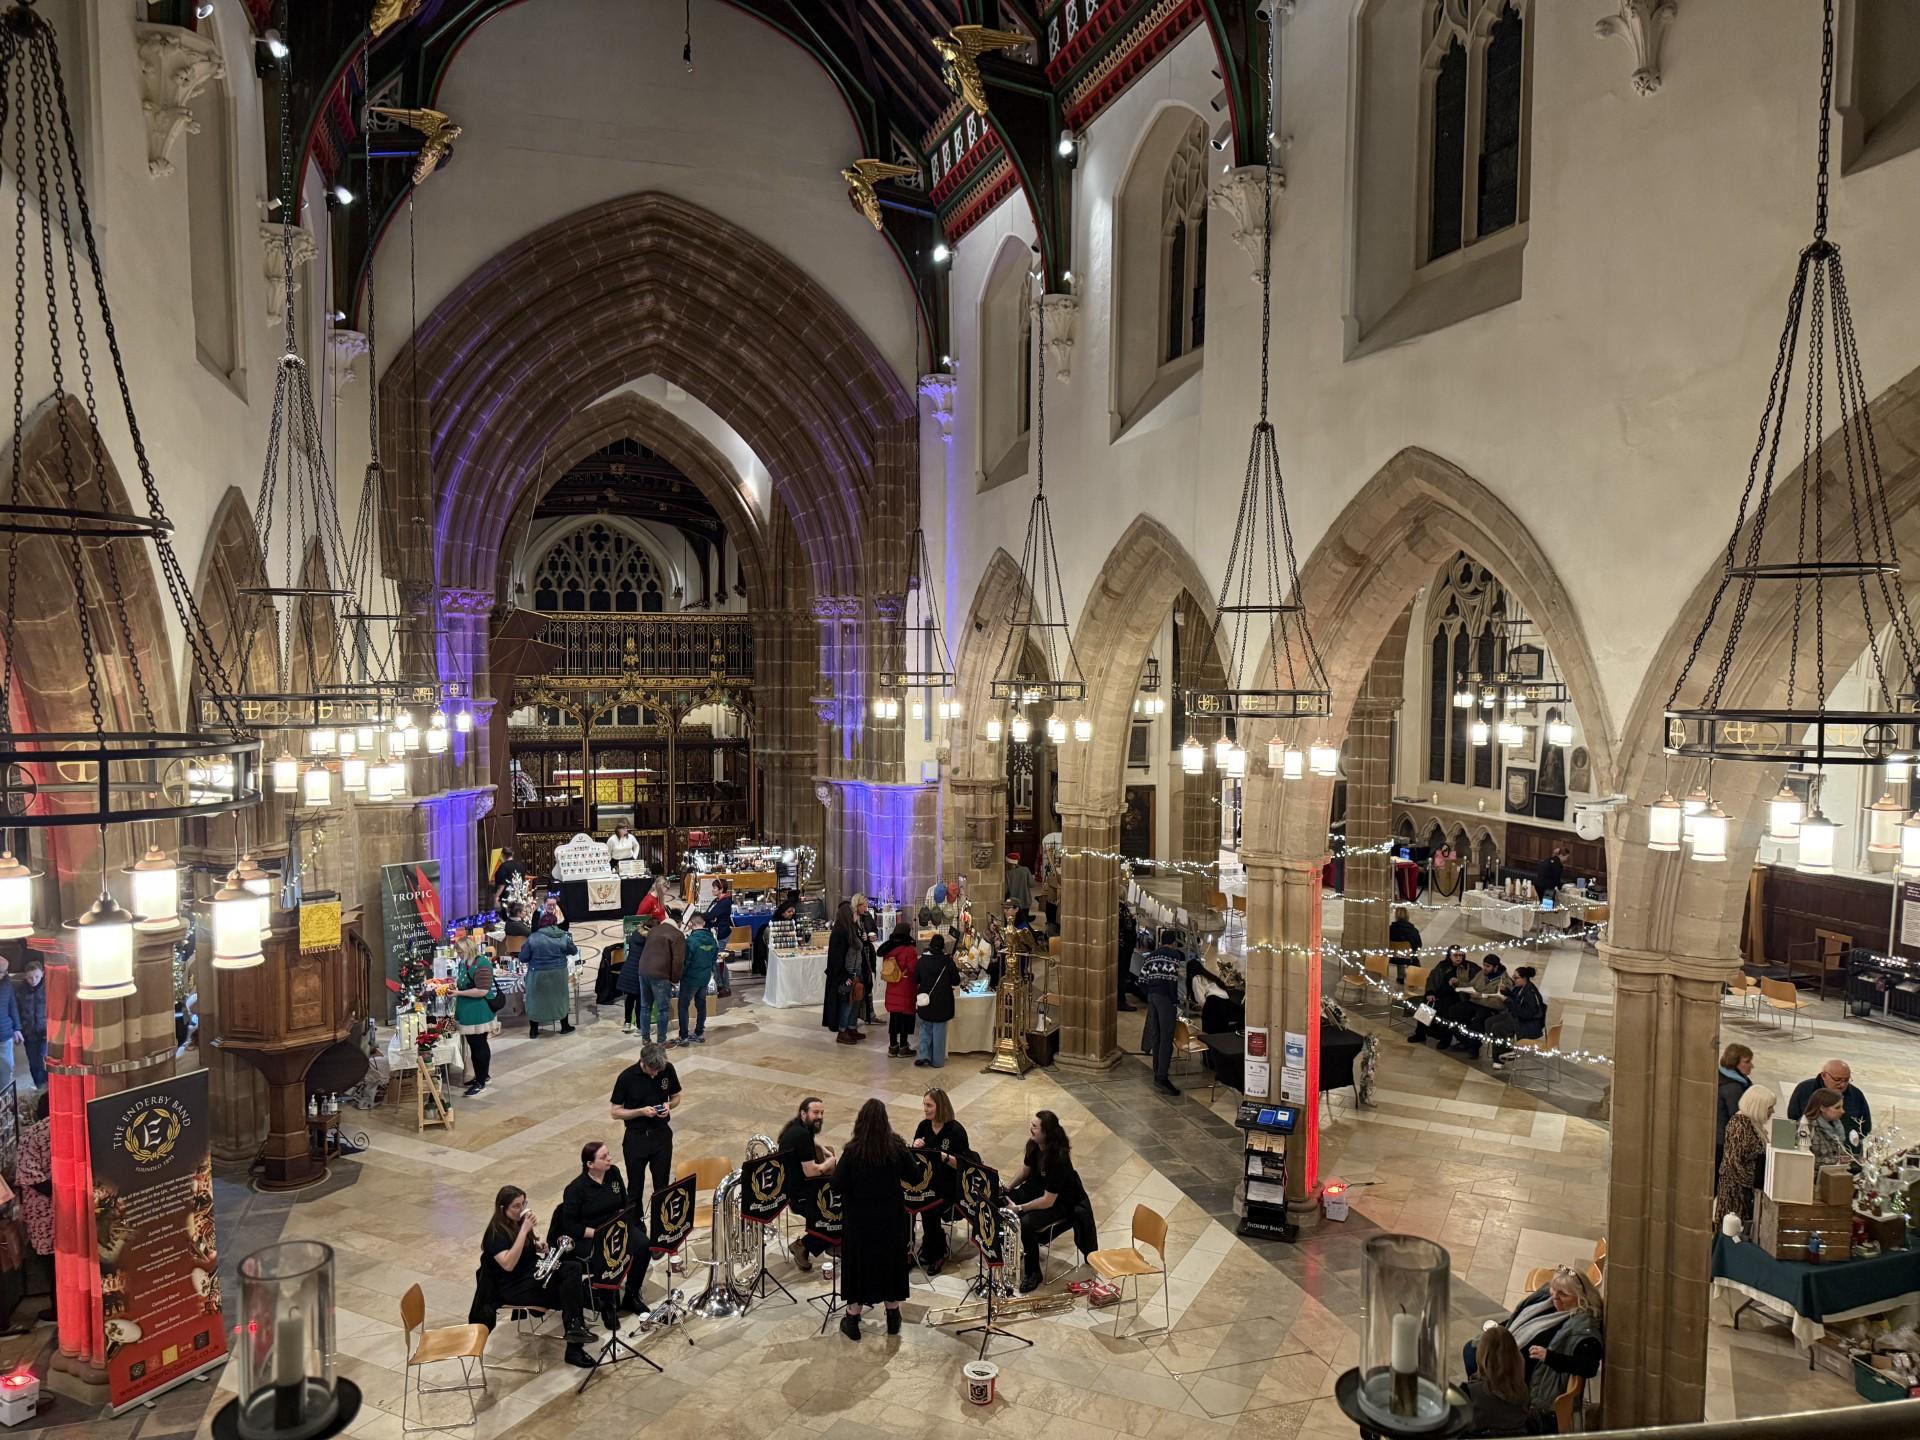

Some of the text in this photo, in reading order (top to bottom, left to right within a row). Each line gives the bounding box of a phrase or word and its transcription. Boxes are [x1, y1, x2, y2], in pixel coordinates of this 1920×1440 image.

[392, 889, 433, 903] TROPIC
[390, 924, 399, 932] To
[401, 920, 416, 932] help
[113, 1096, 192, 1150] THE ENDERBY BAND
[143, 1117, 162, 1148] E
[136, 1163, 162, 1172] FOUNDED
[140, 1186, 154, 1194] largest
[161, 1223, 172, 1231] Band
